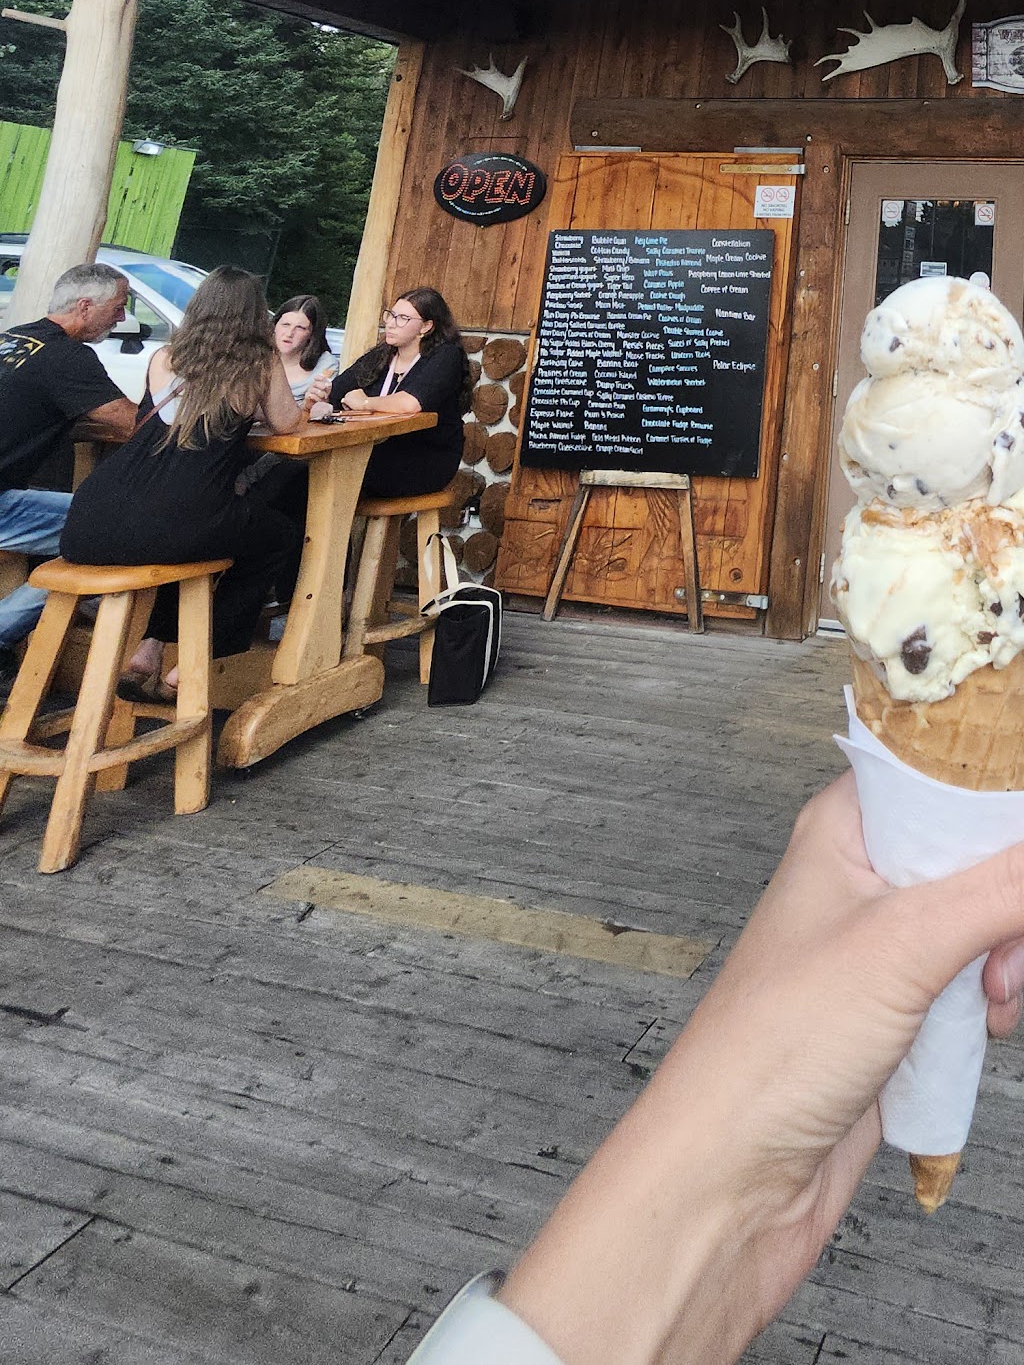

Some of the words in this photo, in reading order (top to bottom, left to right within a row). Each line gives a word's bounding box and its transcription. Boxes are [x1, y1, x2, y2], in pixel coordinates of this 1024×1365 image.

[440, 163, 536, 205] OPEN
[592, 236, 613, 244] Bubble
[591, 246, 611, 254] Cotton
[706, 254, 723, 264] Maple
[725, 253, 743, 262] Cream
[745, 252, 767, 261] Cookie
[713, 360, 730, 370] Polar
